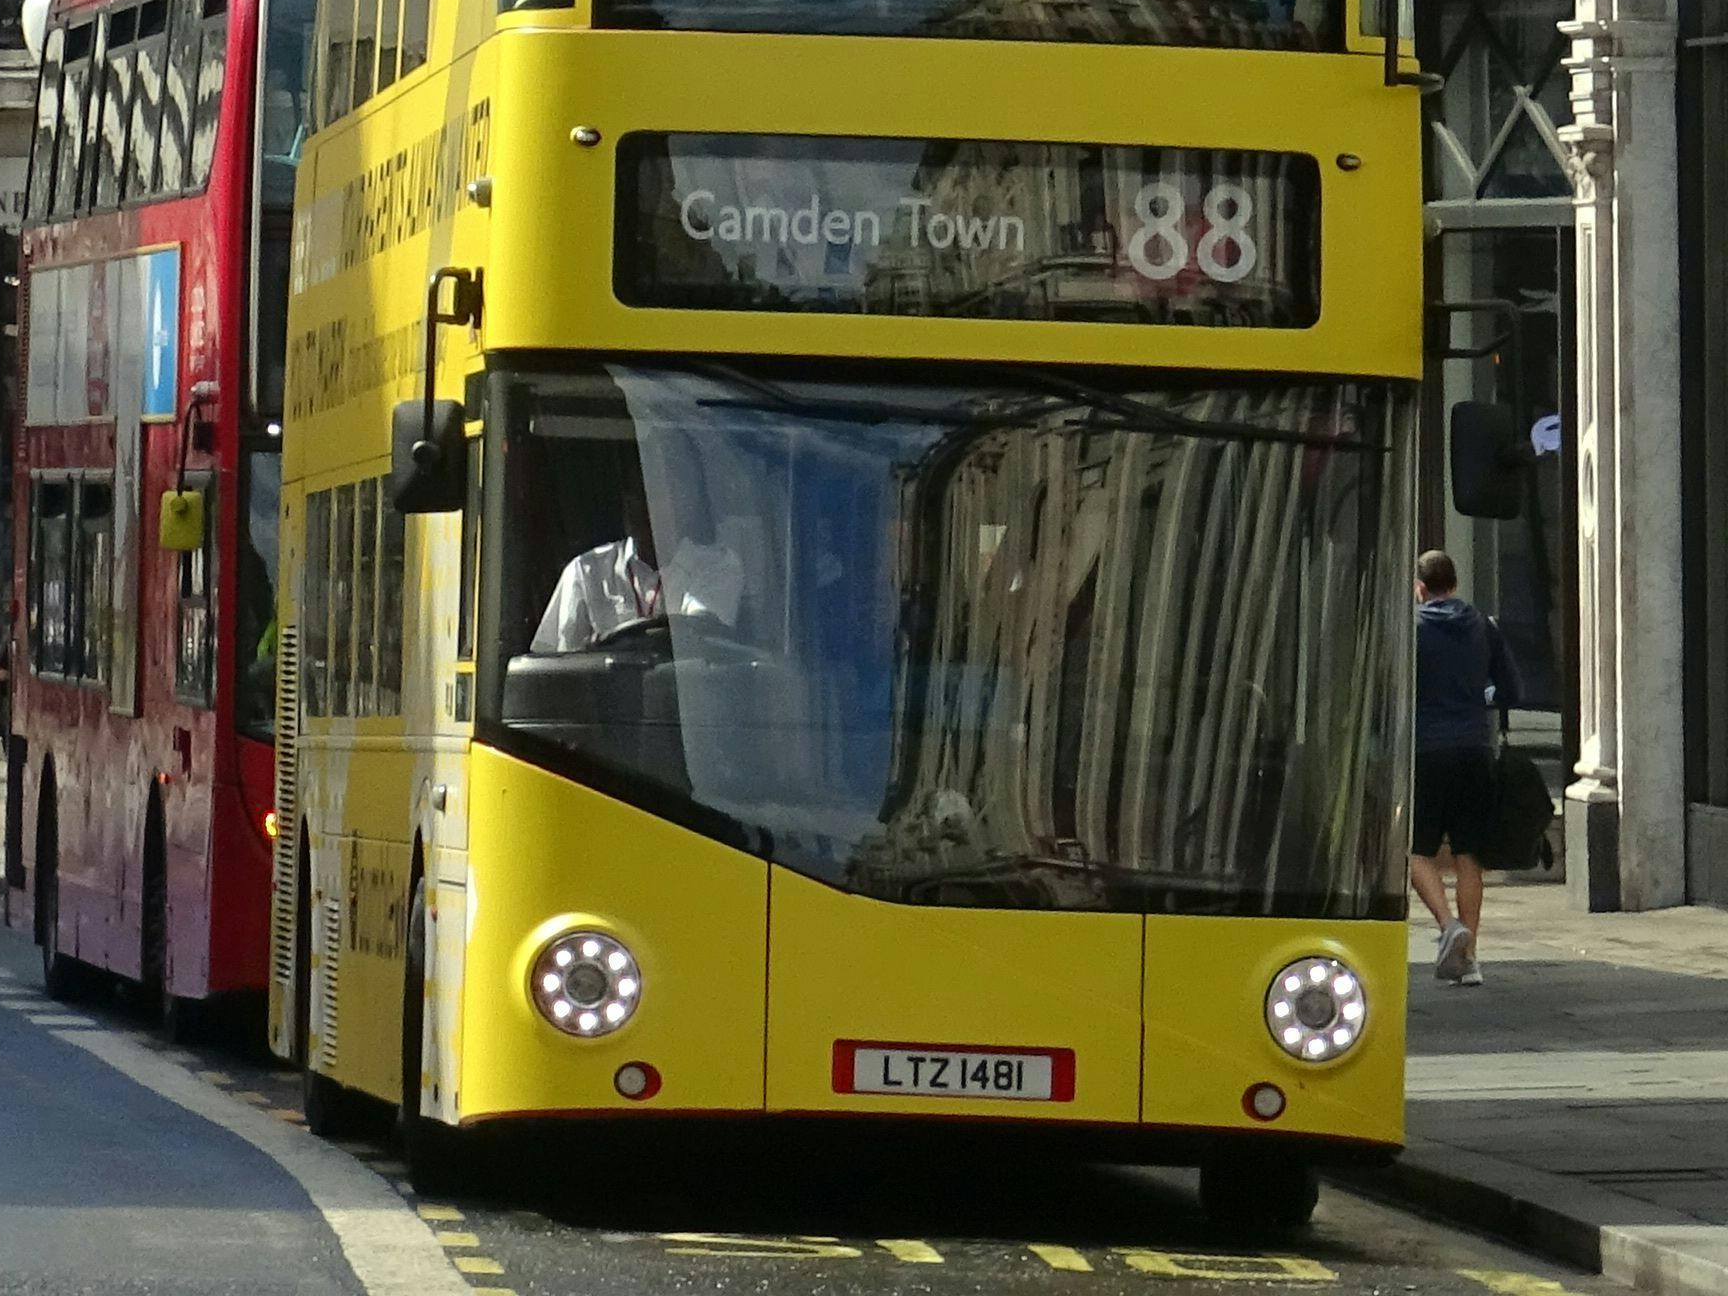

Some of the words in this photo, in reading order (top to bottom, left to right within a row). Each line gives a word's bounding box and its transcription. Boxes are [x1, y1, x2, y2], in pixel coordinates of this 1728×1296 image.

[680, 189, 880, 247] Camden
[899, 197, 1027, 253] Town
[1128, 183, 1257, 283] 88
[882, 1055, 949, 1088] LTZ
[960, 1058, 1024, 1092] 1481
